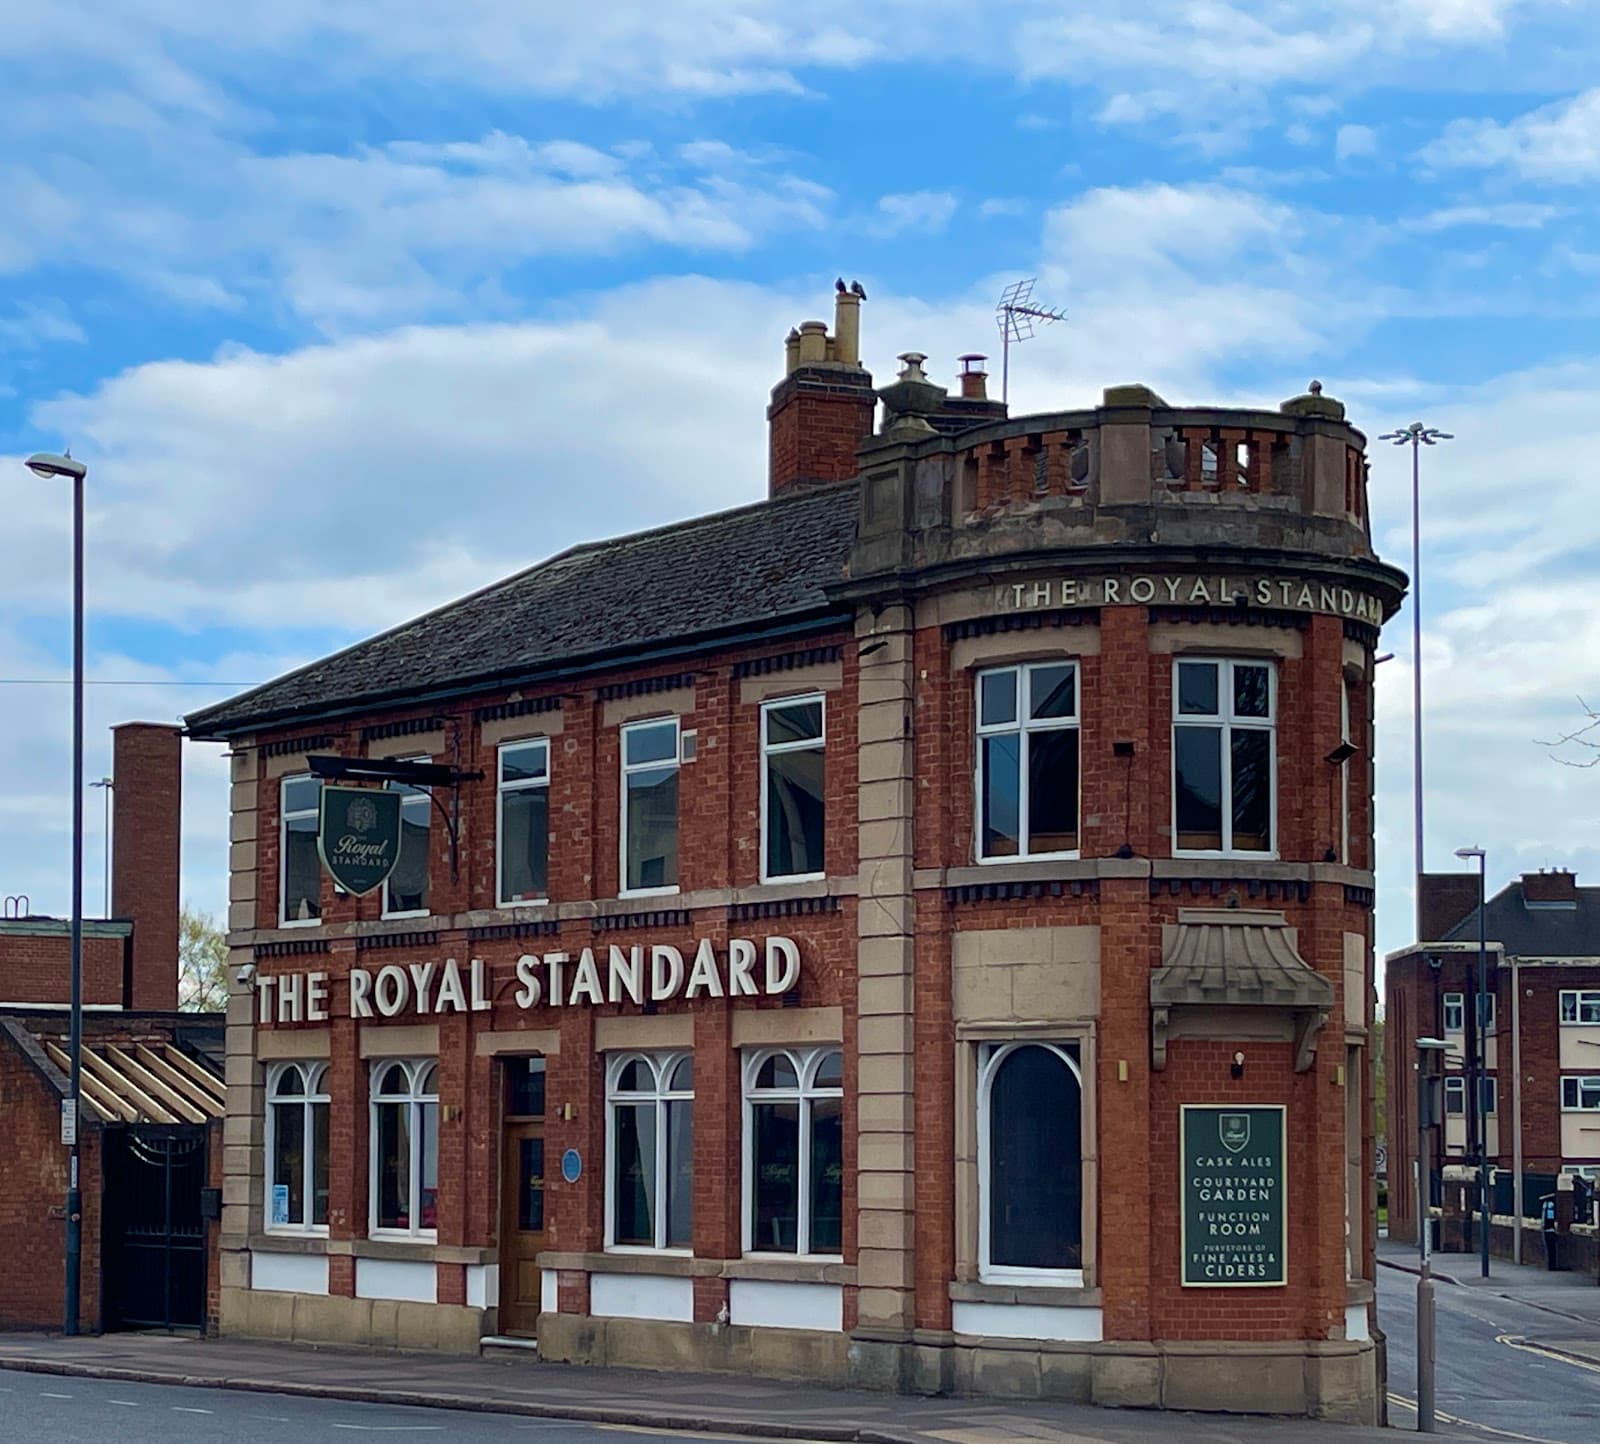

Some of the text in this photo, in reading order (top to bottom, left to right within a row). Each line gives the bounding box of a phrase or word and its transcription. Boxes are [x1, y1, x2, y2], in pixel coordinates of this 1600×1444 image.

[1012, 580, 1077, 608] THE
[1103, 577, 1234, 603] ROYAL
[333, 834, 389, 859] Royal
[256, 936, 802, 1024] THE ROYAL STANDARD
[1195, 1157, 1272, 1167] CASK ALES
[1193, 1177, 1276, 1188] COURTYARD
[1199, 1188, 1270, 1201] GARDEN
[1199, 1212, 1270, 1222] FUNCTION
[1209, 1223, 1261, 1236] ROOM
[1193, 1252, 1276, 1264] FINE ALES &
[1204, 1264, 1267, 1277] CIDERS
